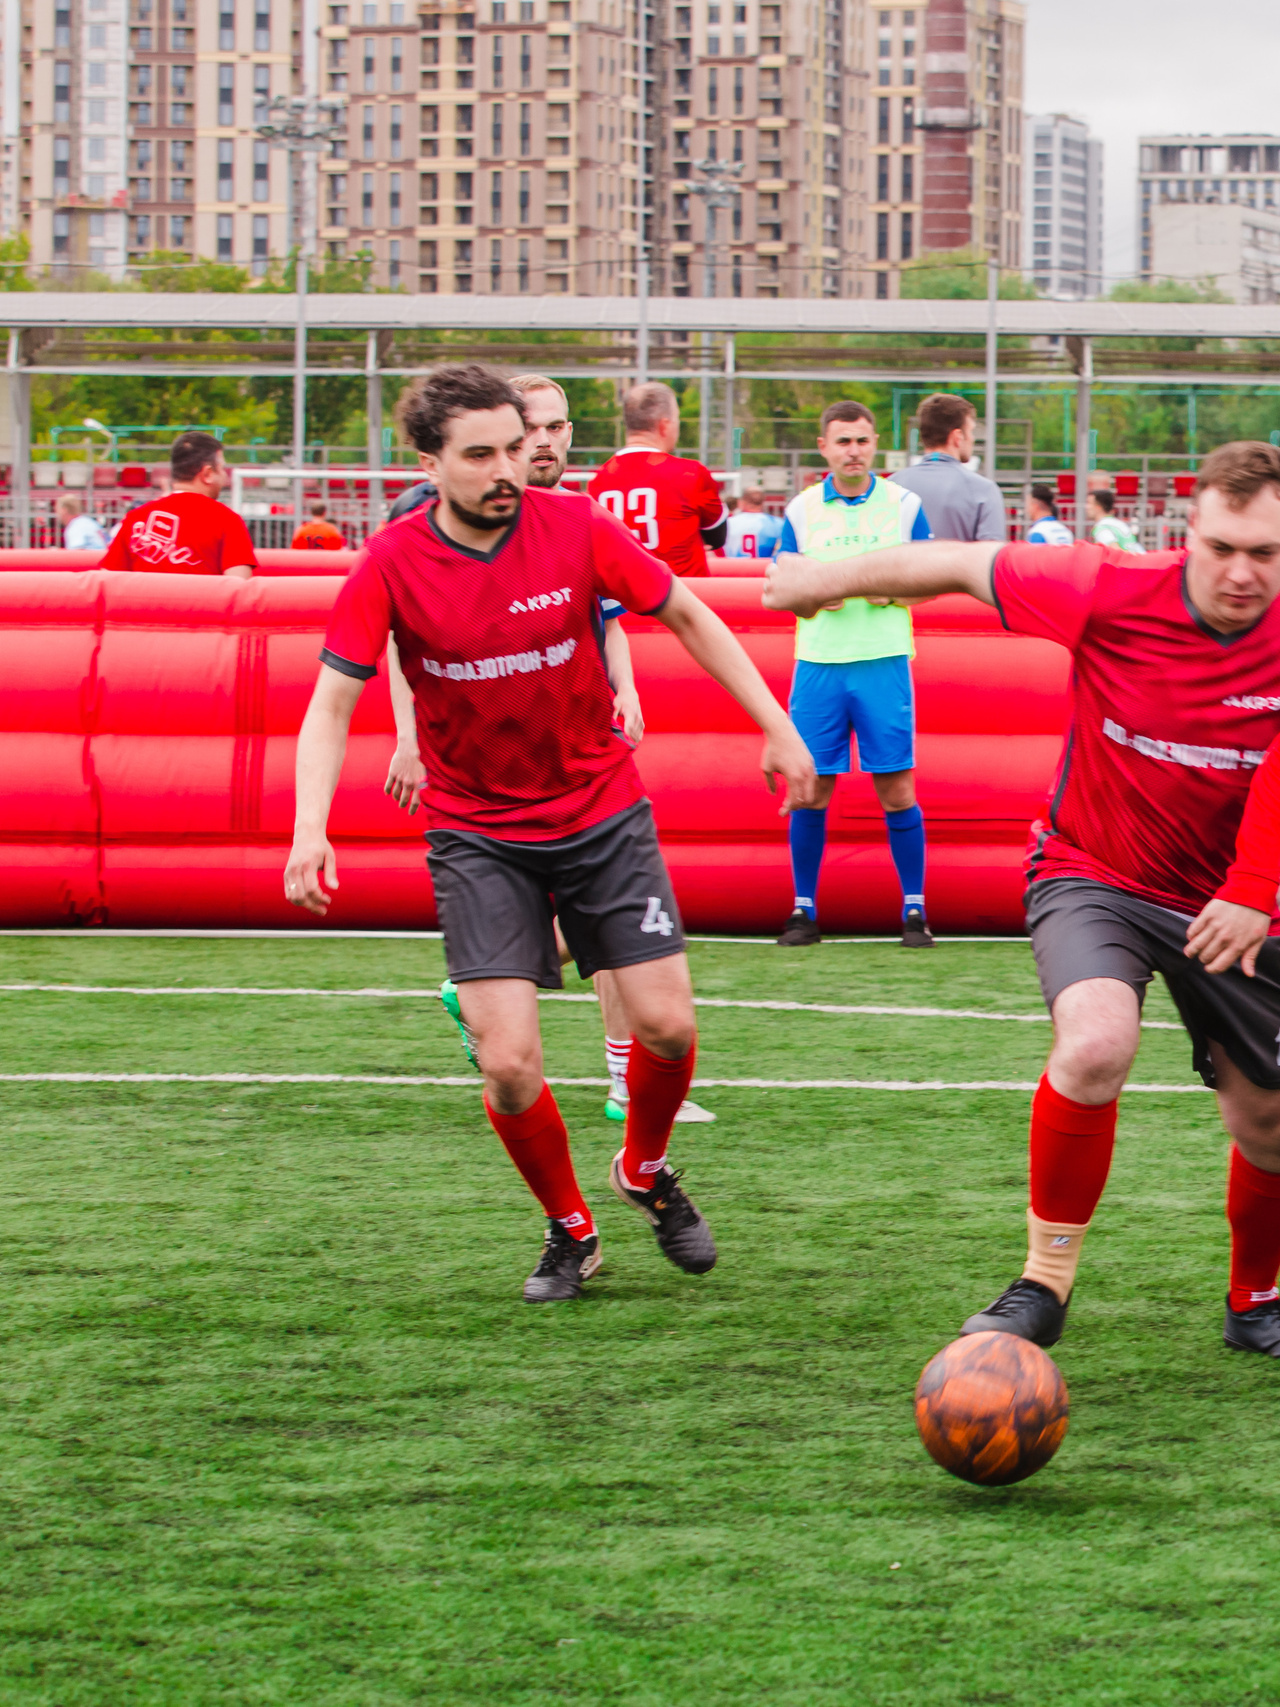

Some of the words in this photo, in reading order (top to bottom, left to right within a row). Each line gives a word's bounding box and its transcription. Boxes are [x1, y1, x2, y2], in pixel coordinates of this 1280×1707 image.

[742, 534, 757, 558] 9
[526, 587, 573, 612] КРЭТ
[640, 896, 674, 936] 4
